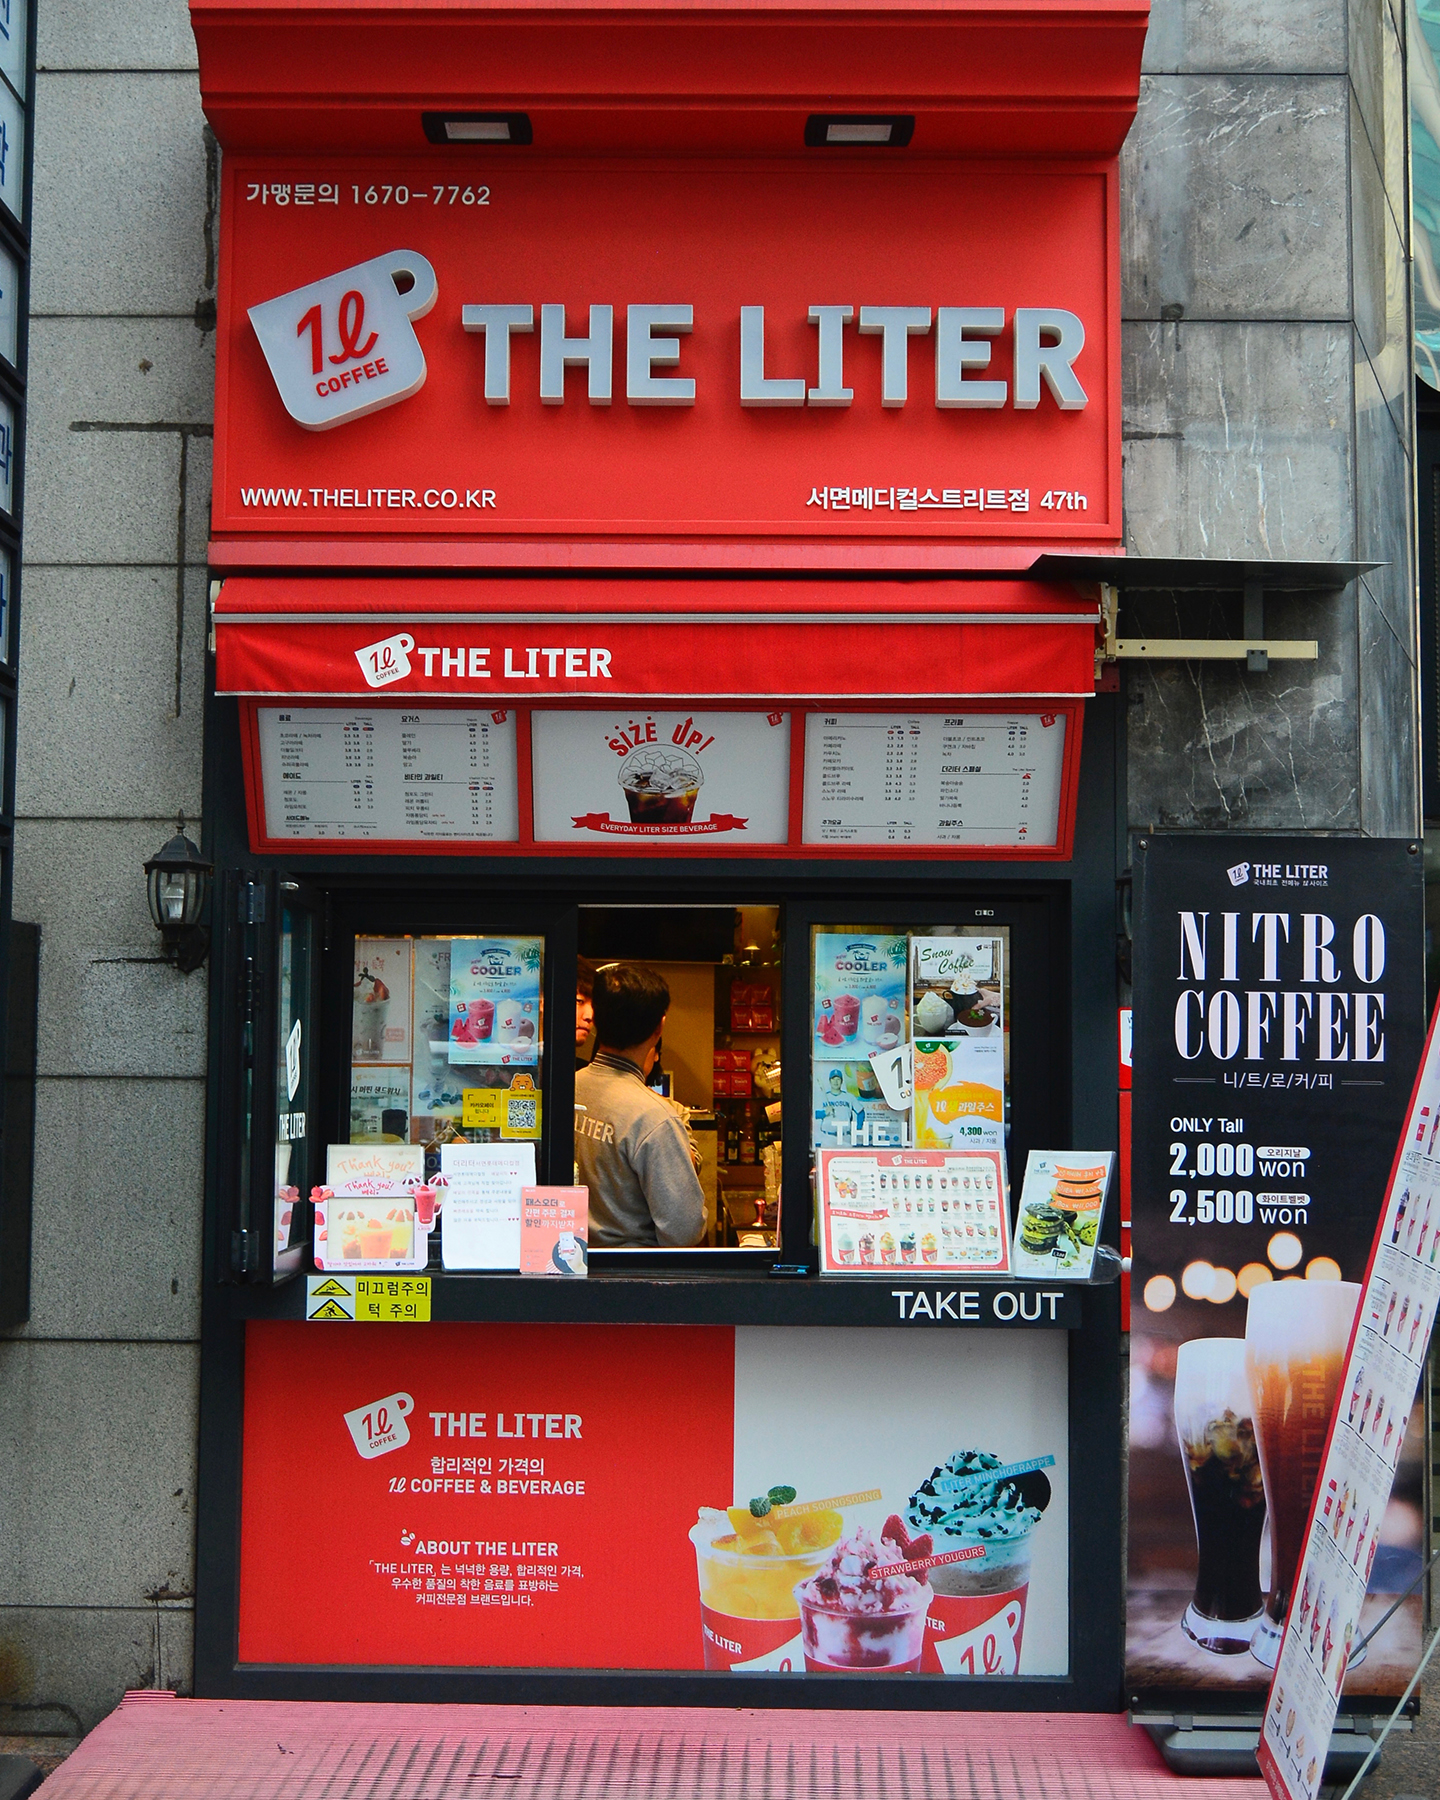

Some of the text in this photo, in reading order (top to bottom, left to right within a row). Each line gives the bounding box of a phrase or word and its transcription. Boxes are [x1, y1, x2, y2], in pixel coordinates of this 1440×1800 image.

[247, 183, 491, 205] 가맹문의 1670-7762
[462, 304, 1089, 410] THE LITER
[316, 358, 389, 397] COFFEE
[241, 488, 496, 509] WWW.THELITER.CO.KR
[805, 487, 1088, 512] 서면메디컬스트리트점 47th
[418, 647, 612, 678] THE LITER
[375, 666, 400, 680] COFFEE
[605, 717, 715, 757] SIZE UP!
[600, 823, 718, 833] EVERYDAY LITER SIZE BEVERAGE
[1253, 864, 1328, 879] THE LITER
[921, 948, 954, 962] Snow
[1177, 912, 1386, 984] NITRO
[470, 965, 522, 976] COOLER
[835, 960, 887, 971] COOLER
[938, 957, 974, 974] Coffee
[1174, 990, 1385, 1062] COFFEE
[1223, 1072, 1334, 1090] 니/트/로/커/피
[279, 1112, 306, 1141] THE LITER
[831, 1121, 890, 1146] THE
[960, 1127, 983, 1136] 4,300
[1170, 1118, 1243, 1133] ONLY Tall
[1169, 1143, 1254, 1179] 2,000
[1266, 1148, 1302, 1158] 오리지날
[1258, 1160, 1306, 1178] won
[525, 1198, 566, 1207] 패스오더로
[1169, 1189, 1254, 1225] 2,500
[1262, 1194, 1307, 1205] 화이트벨벳
[525, 1209, 541, 1218] 간편
[542, 1209, 557, 1218] 주문
[1258, 1207, 1309, 1225] won
[358, 1281, 428, 1296] 미끄럼주의
[369, 1304, 417, 1318] 턱 주의
[892, 1291, 1064, 1321] TAKE OUT
[429, 1412, 583, 1438] THE LITER
[369, 1433, 397, 1449] COFFEE
[430, 1457, 544, 1476] 합리적인 가격의
[411, 1479, 475, 1493] COFFEE
[480, 1480, 492, 1493] &
[497, 1480, 585, 1495] BEVERAGE
[943, 1477, 972, 1491] LITER
[776, 1491, 880, 1518] PEACH SOONGSOONG
[415, 1541, 559, 1557] ABOUT THE LITER
[441, 1564, 451, 1575] 는
[455, 1564, 486, 1576] 넉넉한
[516, 1564, 557, 1577] 합리적인
[871, 1546, 985, 1579] STRAWBERRY YOUGURS
[391, 1578, 559, 1592] 우수한 품질의 착한 음료를 표방하는
[416, 1594, 534, 1607] 커피전문점 브랜드입니다.
[925, 1616, 945, 1632] TER
[715, 1633, 742, 1654] LITER
